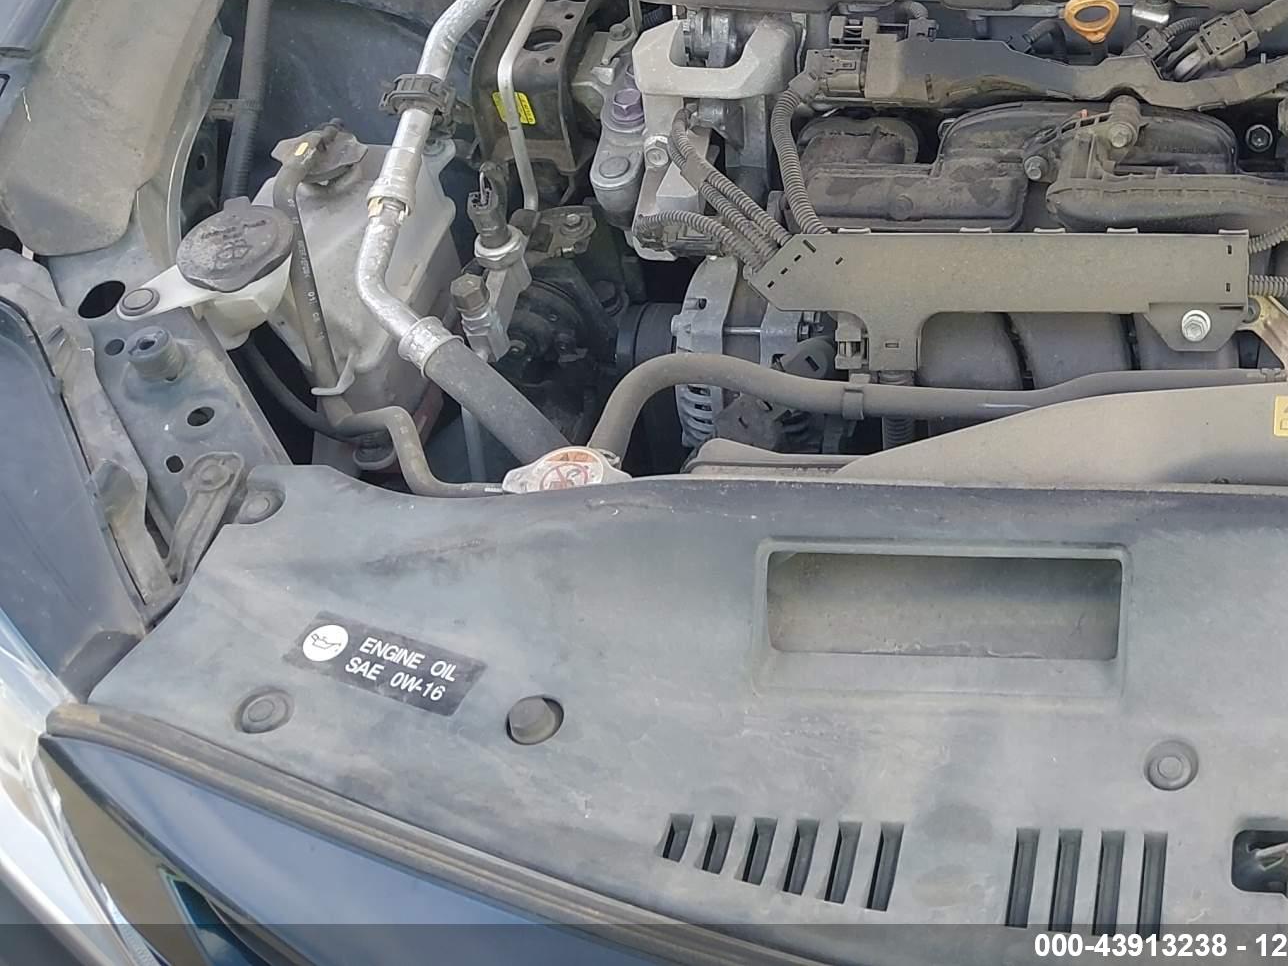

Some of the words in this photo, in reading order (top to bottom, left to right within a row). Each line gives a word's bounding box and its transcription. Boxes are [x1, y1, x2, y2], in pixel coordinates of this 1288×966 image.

[344, 656, 385, 681] SAE
[389, 671, 446, 702] 0W-16
[359, 636, 426, 670] ENGINE
[429, 660, 457, 683] OIL
